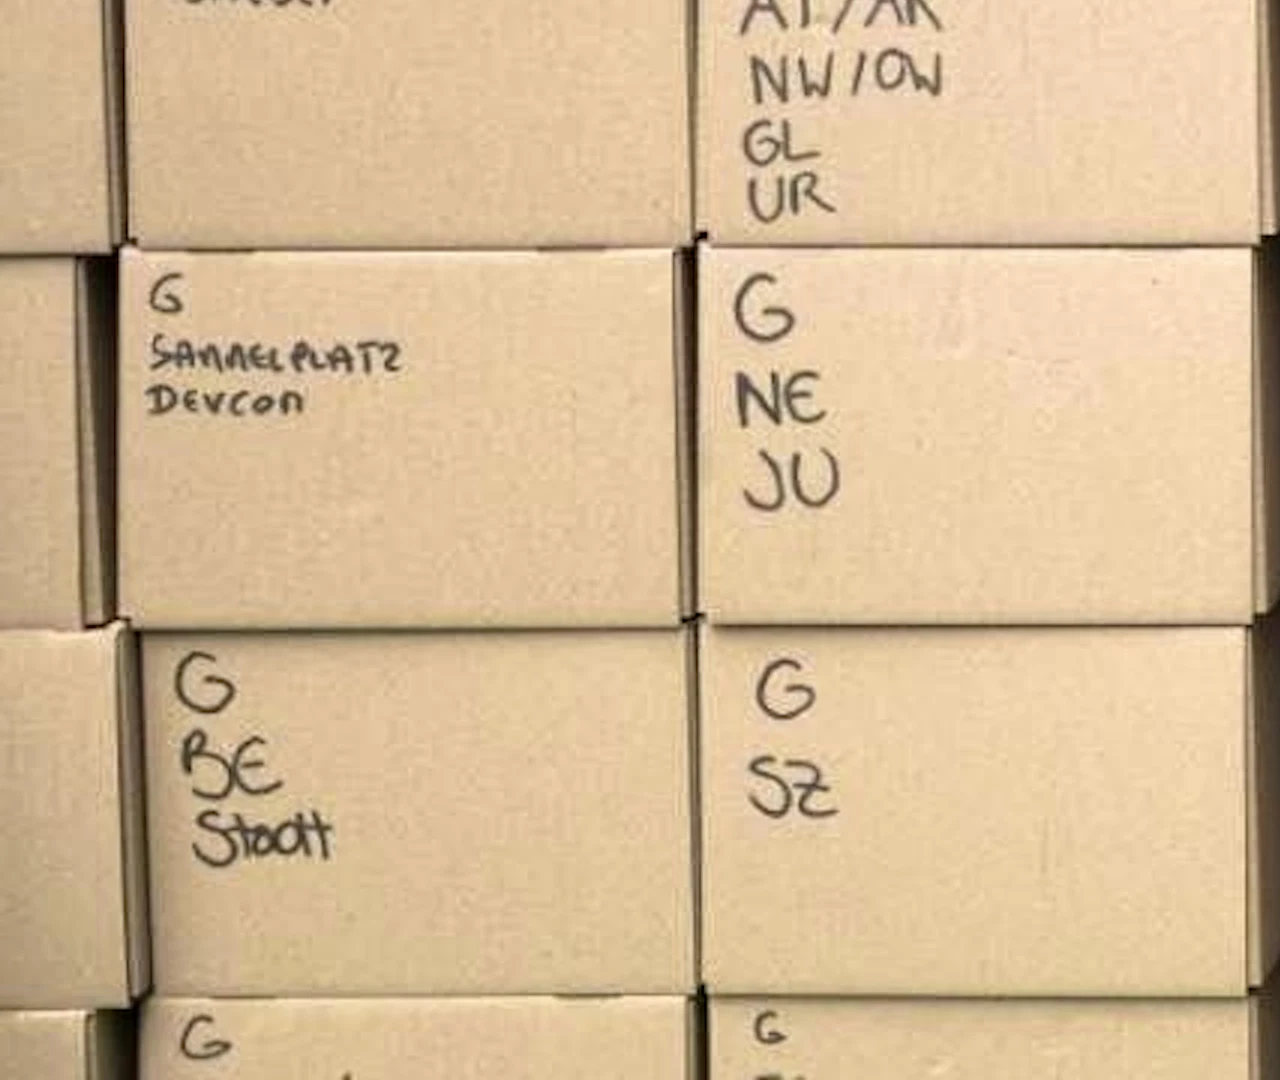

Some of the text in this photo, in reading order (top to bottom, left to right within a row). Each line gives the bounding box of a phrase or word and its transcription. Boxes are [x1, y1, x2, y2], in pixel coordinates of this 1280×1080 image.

[742, 119, 820, 167] GL
[748, 172, 835, 223] UR
[149, 273, 183, 315] G
[734, 273, 795, 343] G
[736, 371, 825, 427] NE
[744, 449, 839, 511] JU
[174, 650, 235, 714] G
[756, 658, 815, 720] G
[181, 729, 282, 801] BE
[749, 756, 837, 818] SZ
[179, 1015, 231, 1060] G
[753, 1009, 788, 1045] G
